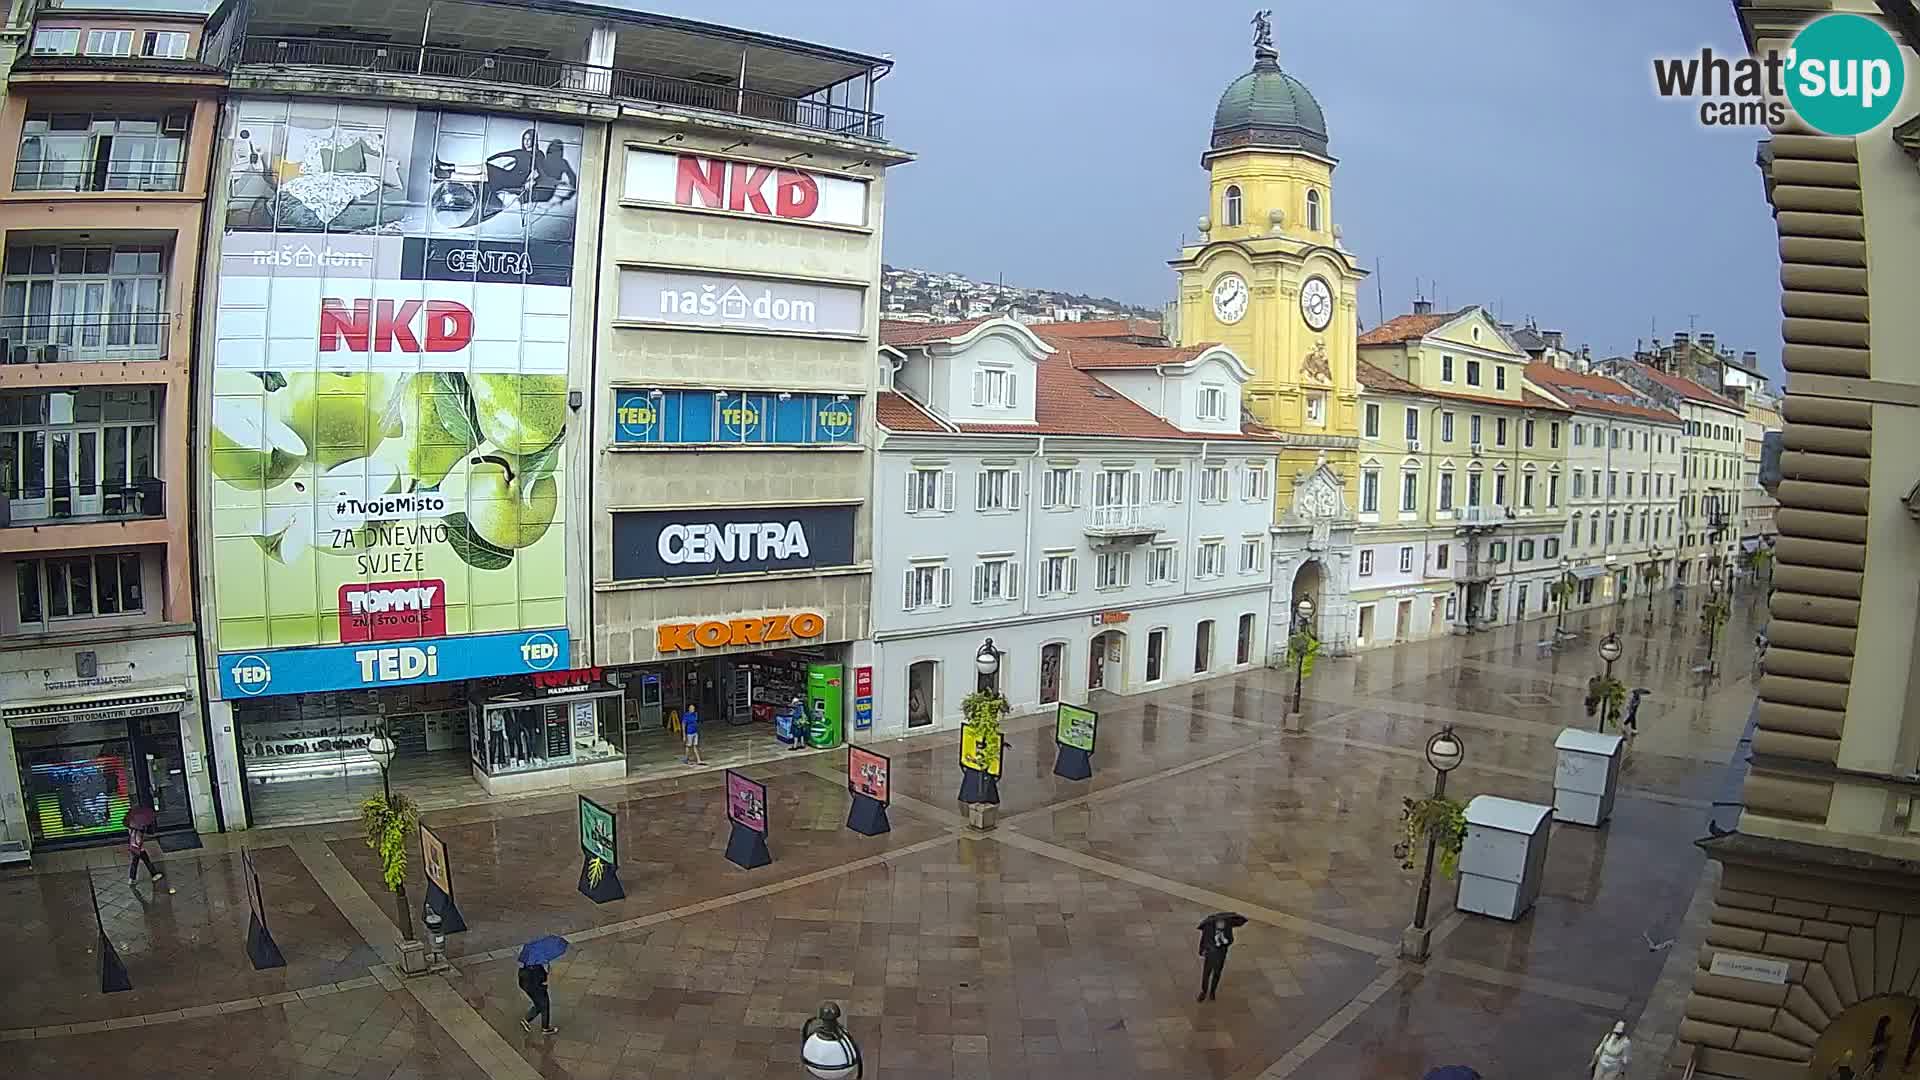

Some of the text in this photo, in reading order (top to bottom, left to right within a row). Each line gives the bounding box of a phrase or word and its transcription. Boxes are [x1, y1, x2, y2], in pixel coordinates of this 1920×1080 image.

[675, 152, 819, 220] NKD
[252, 244, 364, 268] naš dom
[446, 250, 534, 276] CENTRA
[660, 284, 817, 323] naš dom
[319, 298, 475, 353] NKD
[617, 407, 657, 425] TEDi
[722, 408, 759, 425] TEDi
[819, 411, 852, 426] TEDi
[336, 497, 444, 516] #TvojeMisto
[332, 523, 449, 549] ZA DNEVNO
[658, 520, 810, 564] CENTRA
[357, 547, 425, 575] SVJEŽE
[346, 586, 438, 615] TOMMY
[377, 612, 398, 626] ŠTO
[657, 612, 825, 653] KORZO
[520, 642, 559, 661] TEDi
[231, 663, 272, 685] TEDi
[355, 646, 440, 684] TEDi
